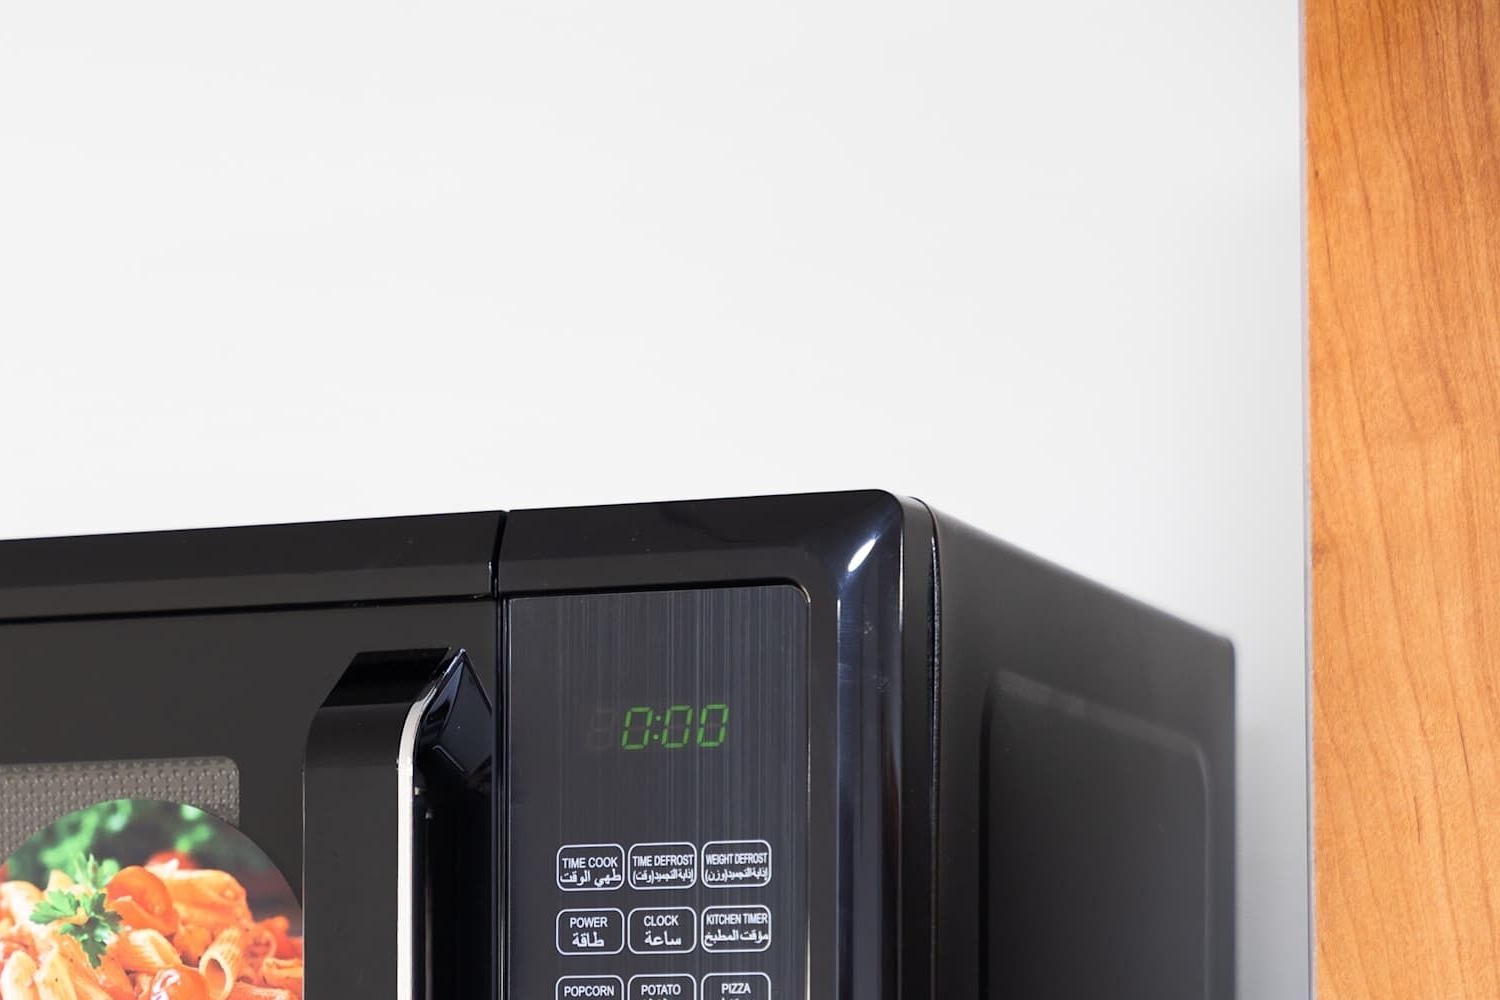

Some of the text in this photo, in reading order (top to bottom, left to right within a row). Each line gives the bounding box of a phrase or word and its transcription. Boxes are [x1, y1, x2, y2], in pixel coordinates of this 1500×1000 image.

[621, 704, 729, 750] 0:00
[562, 857, 618, 868] TIME COOK
[632, 854, 694, 866] TIME DEFROST
[706, 853, 768, 864] WEIGHT DEFROST
[560, 868, 621, 887] طهي الوقت
[570, 917, 608, 928] POWER
[644, 915, 678, 926] CLOCK
[706, 913, 768, 925] KITCHEN TIMER
[572, 932, 604, 948] طاقة
[645, 931, 681, 946] ساعة
[564, 985, 614, 997] POPCORN
[641, 984, 681, 995] POTATO
[722, 983, 751, 994] PIZZA
